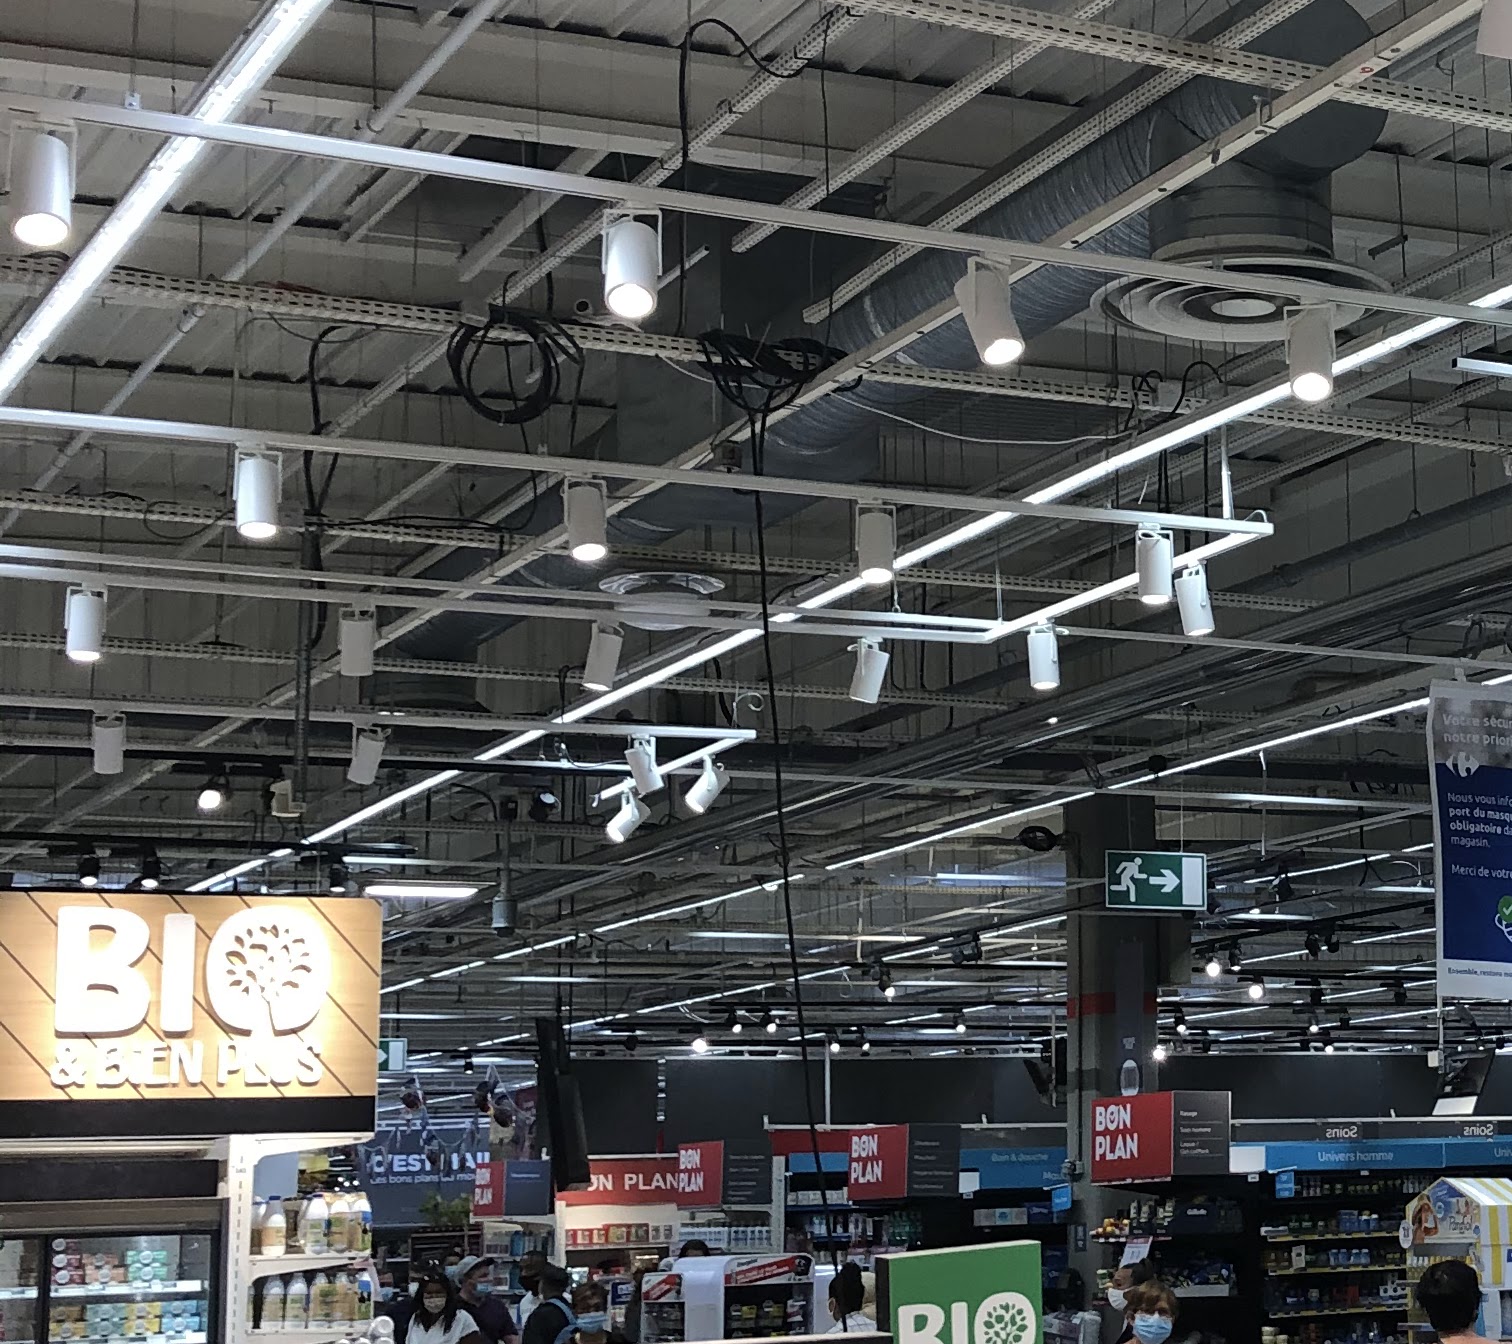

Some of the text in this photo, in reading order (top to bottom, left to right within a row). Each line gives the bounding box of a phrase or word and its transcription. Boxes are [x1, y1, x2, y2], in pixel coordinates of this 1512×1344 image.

[1443, 714, 1480, 726] Votre
[1443, 733, 1480, 743] notre
[1447, 792, 1473, 803] Nous
[1475, 796, 1496, 804] vous
[1448, 807, 1470, 817] port
[1473, 807, 1485, 817] du
[1450, 820, 1501, 834] obligatoire
[1450, 836, 1490, 848] magasin.
[1451, 864, 1476, 876] Merci
[1478, 866, 1489, 877] de
[55, 905, 331, 1034] BIO
[50, 1039, 323, 1088] & BIEN PLUS
[1095, 1103, 1131, 1131] BON
[850, 1134, 878, 1158] BON
[1095, 1133, 1139, 1161] PLAN
[679, 1148, 700, 1170] BON
[1317, 1150, 1394, 1162] Univers homme
[587, 1172, 678, 1191] ON PLAN
[850, 1160, 883, 1184] PLAN
[678, 1172, 704, 1193] PLAN
